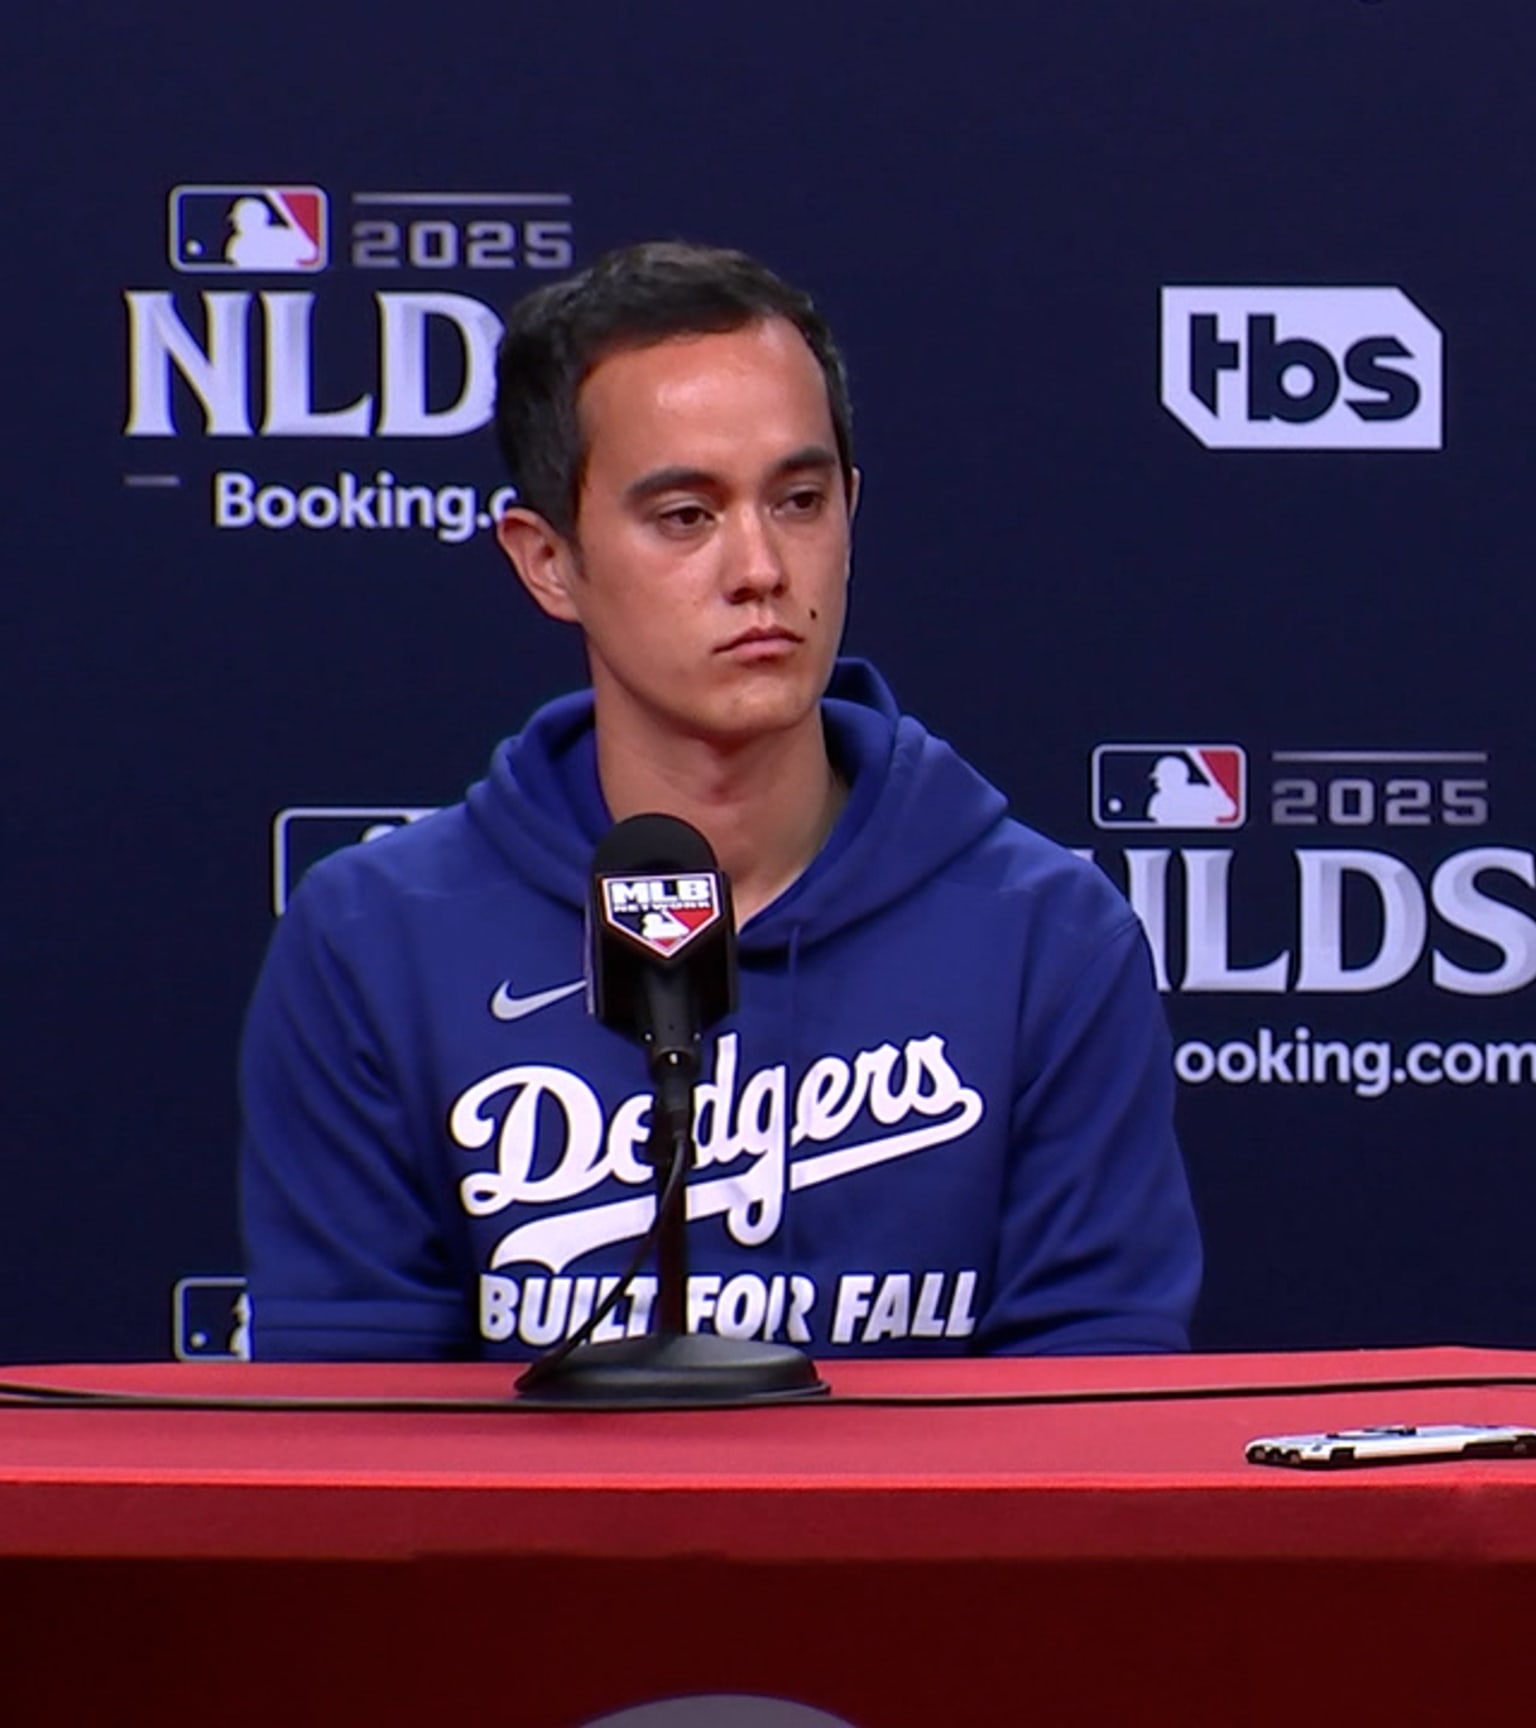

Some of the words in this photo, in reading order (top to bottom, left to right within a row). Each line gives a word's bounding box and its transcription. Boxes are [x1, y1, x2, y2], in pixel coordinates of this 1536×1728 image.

[352, 220, 572, 268] 2025
[124, 289, 505, 436] NLD
[1188, 313, 1422, 424] tbs
[215, 471, 517, 542] Booking.c
[1272, 780, 1488, 825] 2025
[611, 879, 711, 905] MLB
[479, 1273, 659, 1346] BUILT
[686, 1273, 815, 1344] FOR
[831, 1270, 978, 1344] FALL
